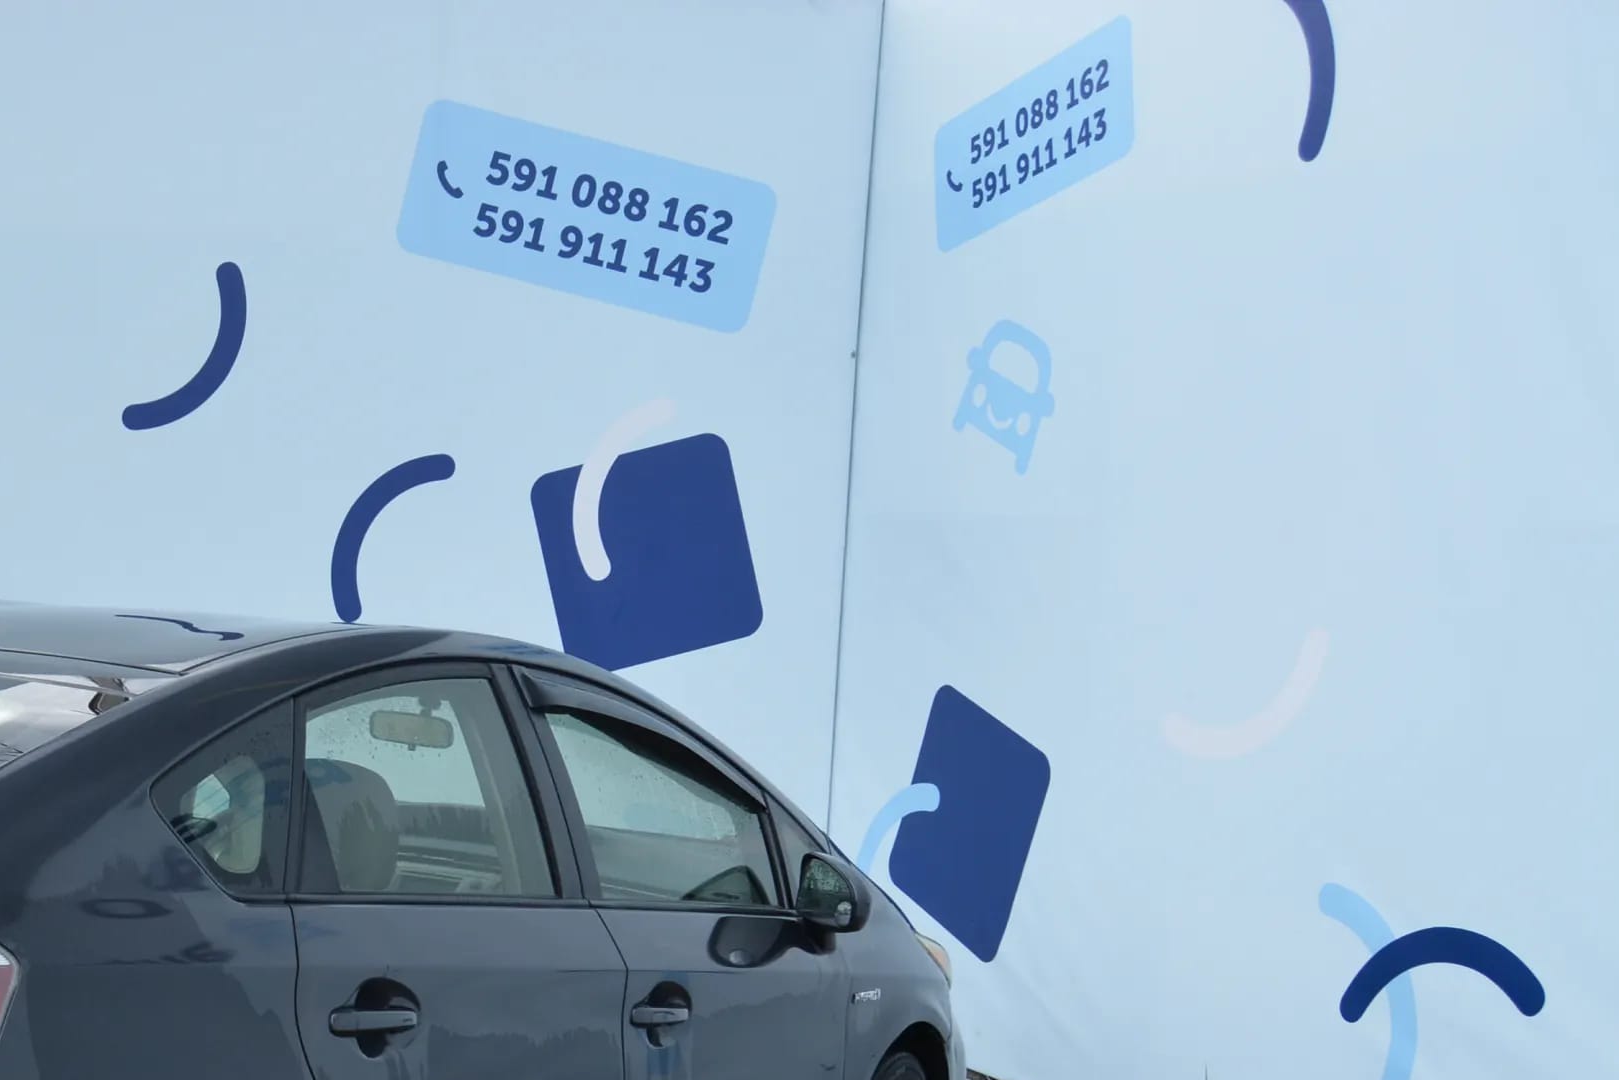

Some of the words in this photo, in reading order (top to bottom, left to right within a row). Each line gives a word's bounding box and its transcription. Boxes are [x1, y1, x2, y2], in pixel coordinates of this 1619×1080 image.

[970, 119, 1010, 165] 591
[1015, 88, 1059, 138] 088
[1065, 59, 1110, 111] 162
[972, 163, 1011, 209] 591
[1016, 137, 1058, 185] 911
[1063, 107, 1107, 159] 143
[485, 150, 558, 201] 591
[571, 173, 650, 223] 088
[657, 196, 734, 245] 162
[472, 202, 546, 253] 591
[557, 224, 628, 274] 911
[638, 246, 716, 294] 143
